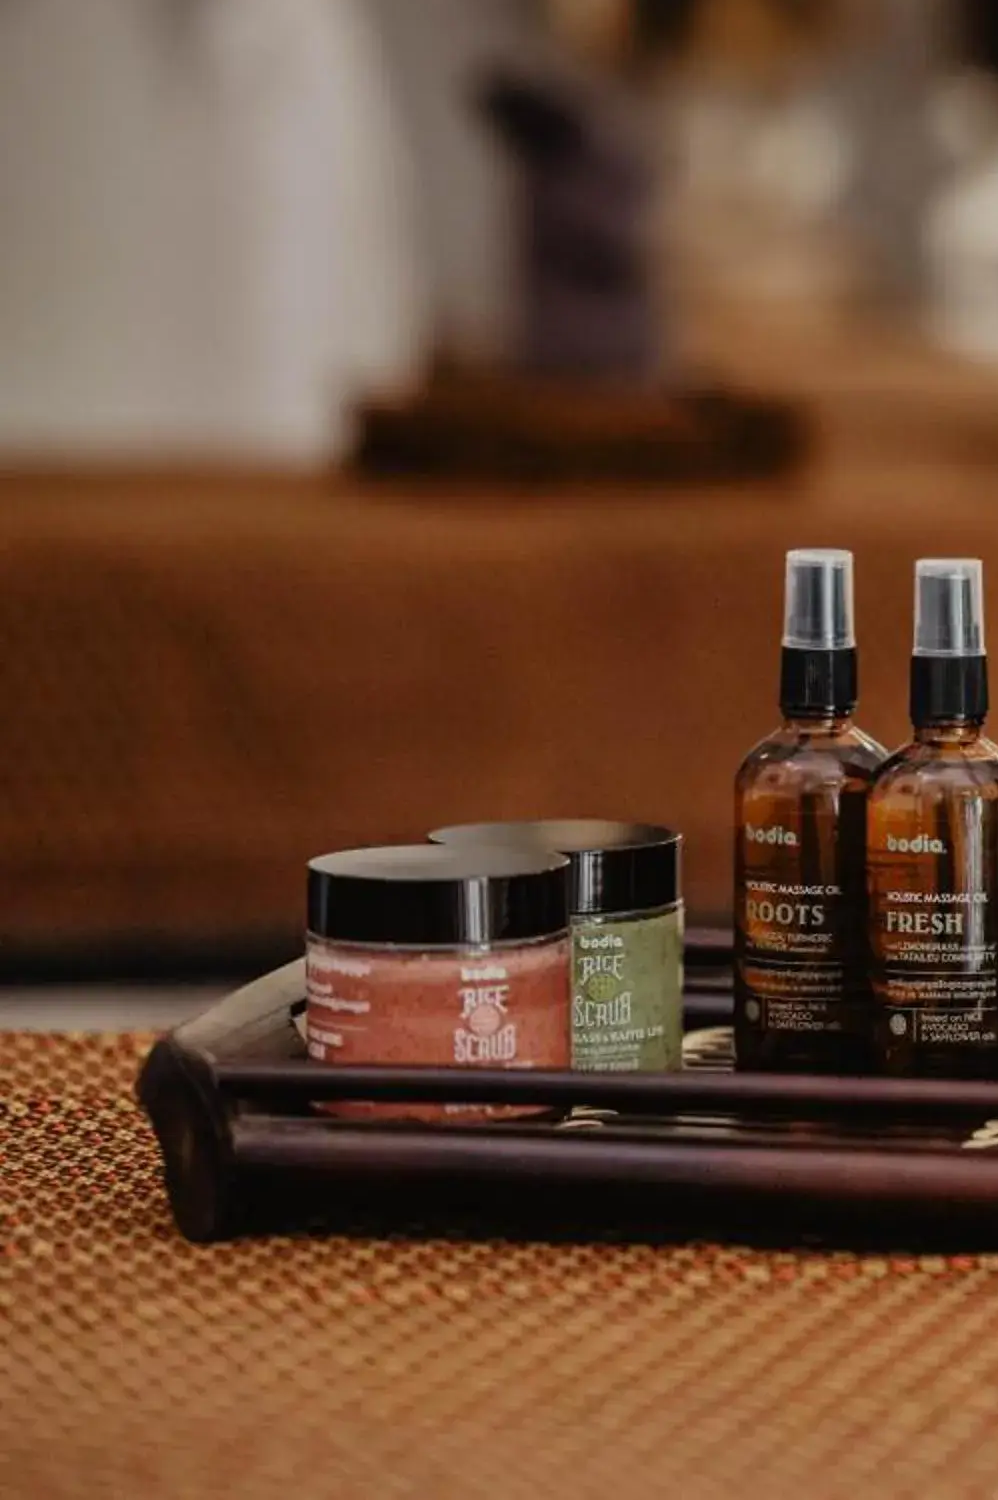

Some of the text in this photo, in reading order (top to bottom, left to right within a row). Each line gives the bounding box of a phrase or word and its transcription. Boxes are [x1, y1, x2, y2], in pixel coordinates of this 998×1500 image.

[778, 883, 823, 896] MASSAGE
[924, 892, 970, 903] MASSAGE
[746, 900, 824, 926] ROOTS
[886, 910, 963, 935] FRESH
[578, 954, 626, 986] RICE
[458, 985, 509, 1019] RICE
[573, 991, 633, 1027] SCRUB
[453, 1024, 516, 1063] SCRUB
